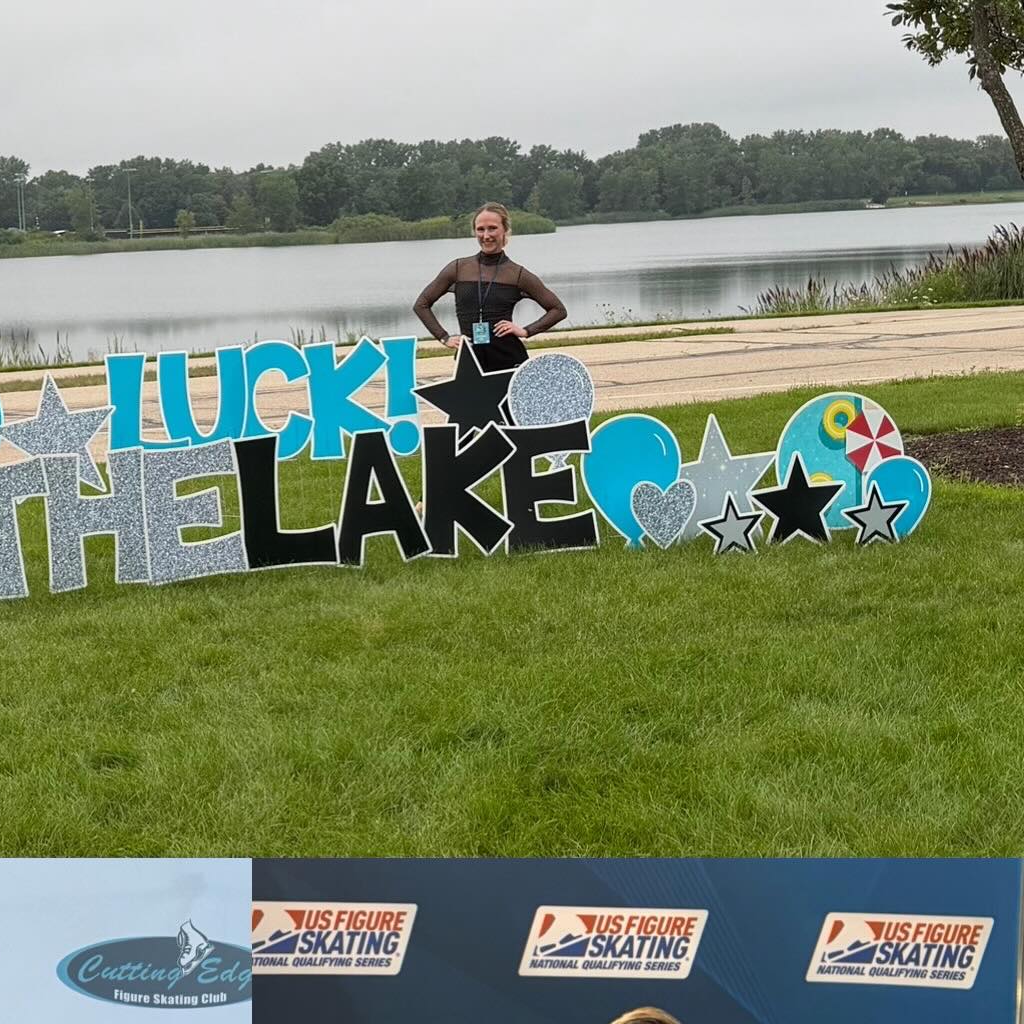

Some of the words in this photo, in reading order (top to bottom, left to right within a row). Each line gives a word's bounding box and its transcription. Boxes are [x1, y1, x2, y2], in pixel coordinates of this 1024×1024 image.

[104, 336, 422, 461] LUCK!
[231, 417, 599, 570] LAKE
[306, 910, 333, 930] US
[334, 911, 407, 931] FIGURE
[596, 915, 624, 934] US
[625, 916, 697, 936] FIGURE
[298, 931, 400, 954] SKATING
[884, 922, 912, 942] US
[912, 923, 984, 945] FIGURE
[589, 935, 690, 959] SKATING
[876, 942, 975, 968] SKATING
[78, 954, 182, 990] Cutting
[197, 957, 252, 990] Edg
[252, 958, 288, 966] TIONAL
[292, 957, 351, 967] QUALIFYING
[355, 958, 392, 967] SERIES
[530, 959, 578, 969] NATIONAL
[582, 960, 641, 970] QUALIFYING
[644, 962, 681, 971] SERIES
[817, 965, 865, 975] NATIONAL
[868, 967, 927, 978] QUALIFYING
[930, 970, 966, 980] SERIES
[114, 989, 150, 1004] Figure
[153, 993, 198, 1005] Skating
[201, 992, 227, 1004] Club
